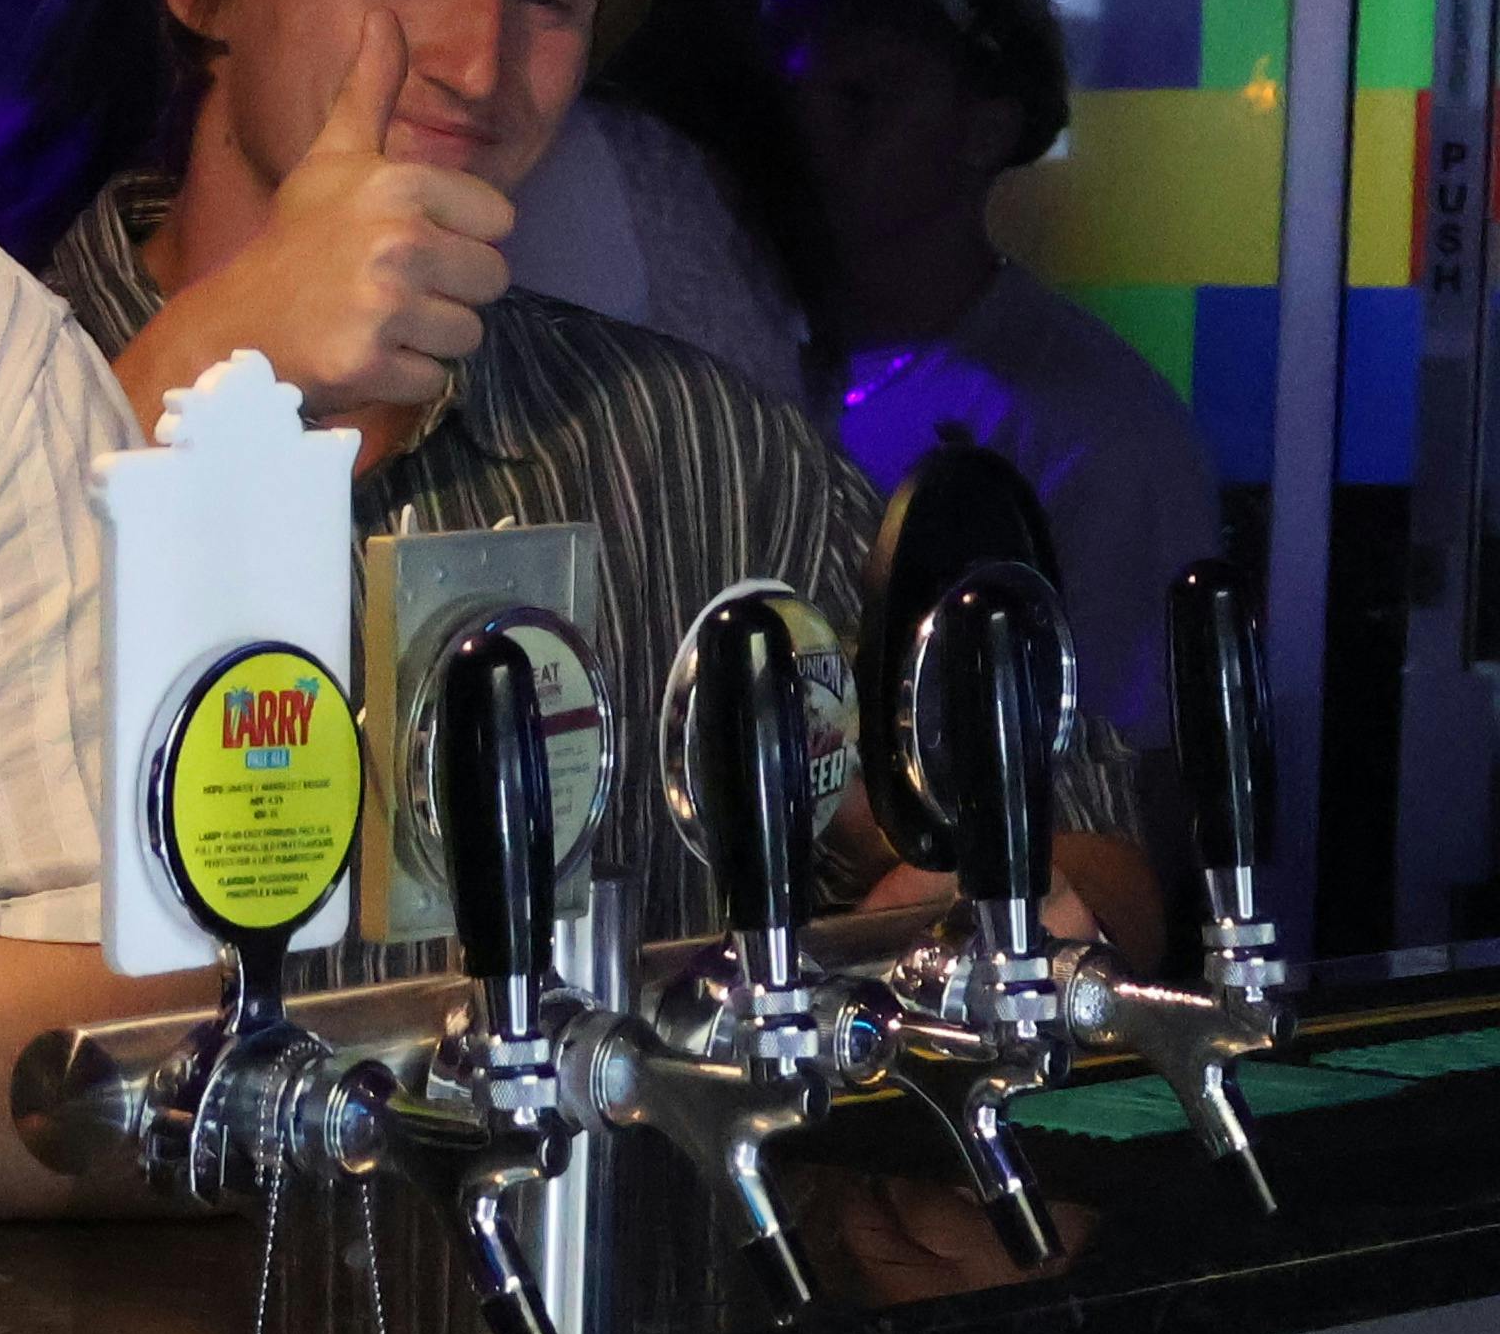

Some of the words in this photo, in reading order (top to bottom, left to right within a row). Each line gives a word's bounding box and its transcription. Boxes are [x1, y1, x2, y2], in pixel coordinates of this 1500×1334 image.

[1433, 142, 1467, 297] PUSH
[222, 687, 319, 749] LARRY
[810, 748, 847, 797] EER
